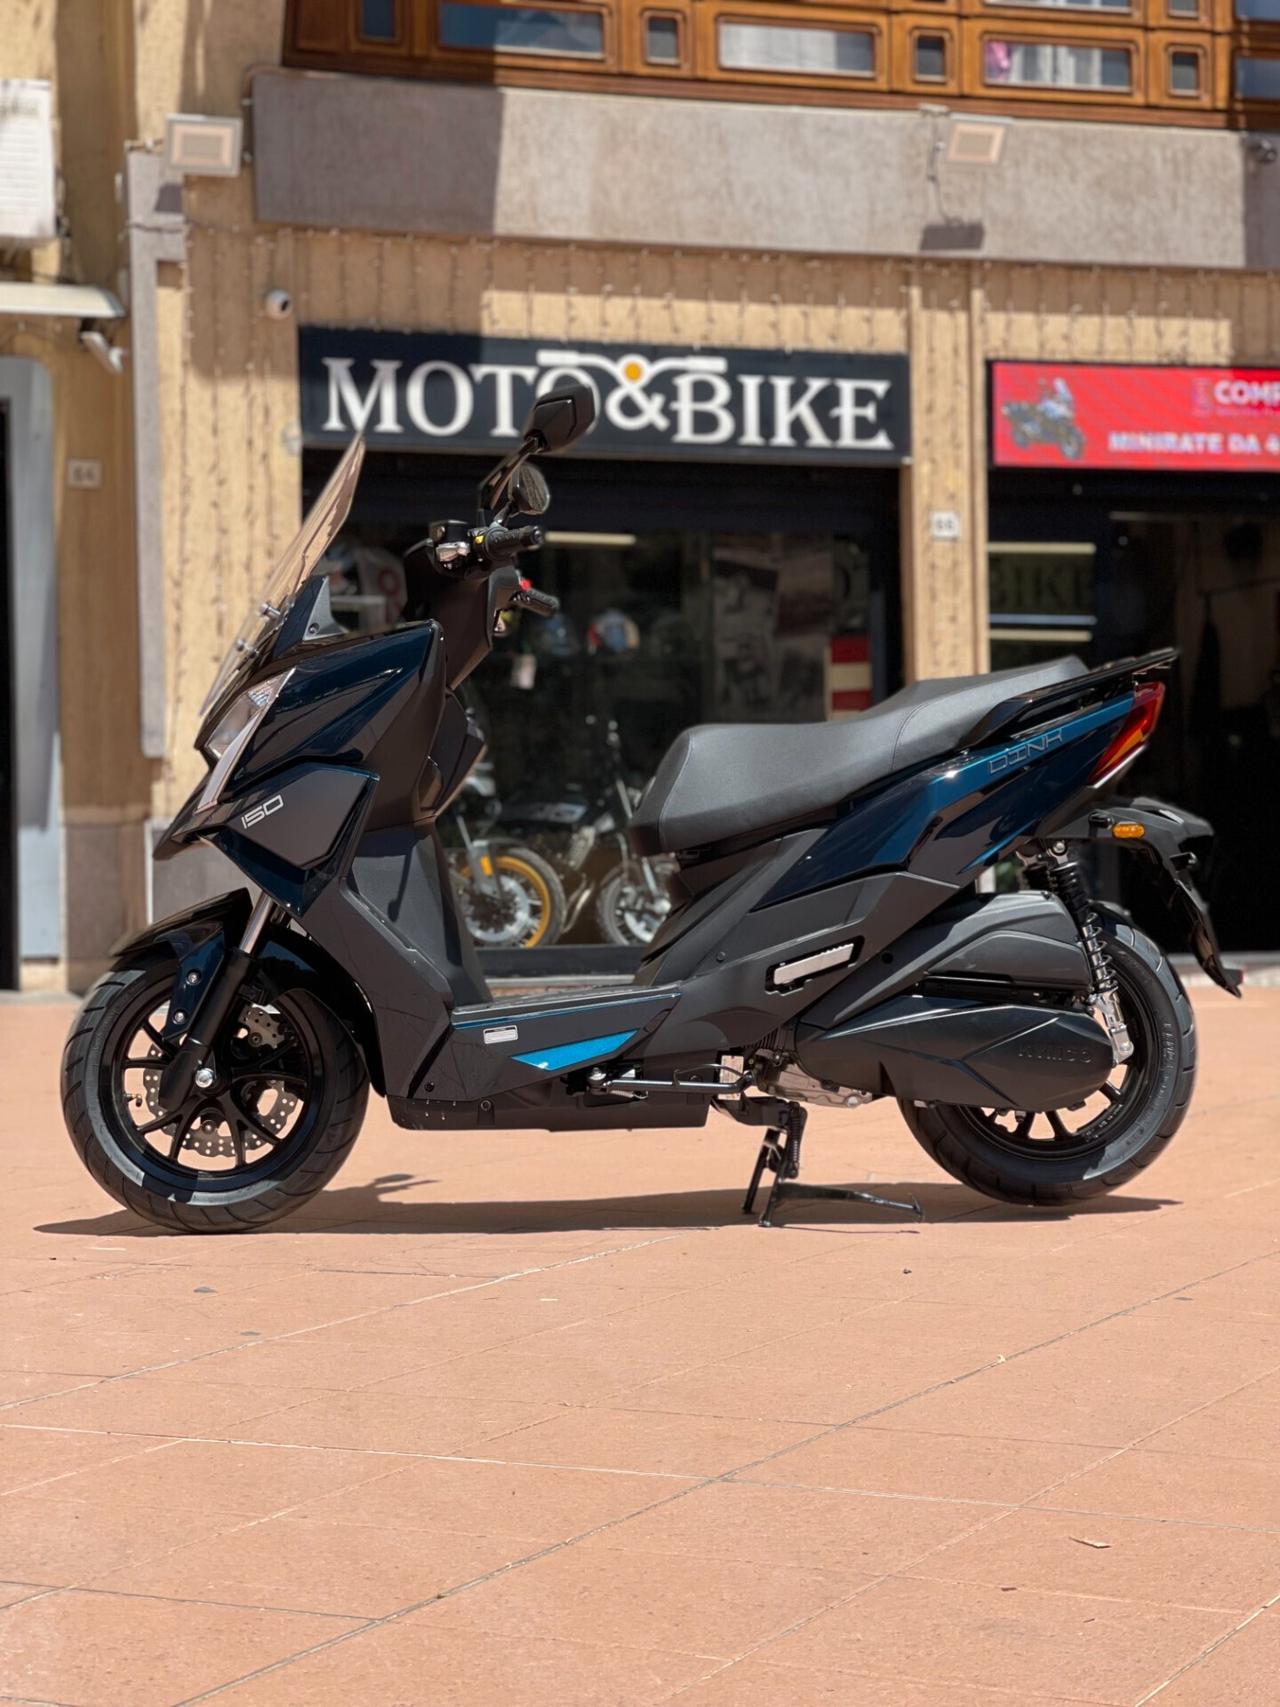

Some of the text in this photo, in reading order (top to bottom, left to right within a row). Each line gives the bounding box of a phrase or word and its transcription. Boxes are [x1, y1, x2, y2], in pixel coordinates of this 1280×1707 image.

[1108, 431, 1223, 455] MINIRATE
[1228, 431, 1261, 456] DA
[241, 794, 284, 829] 150
